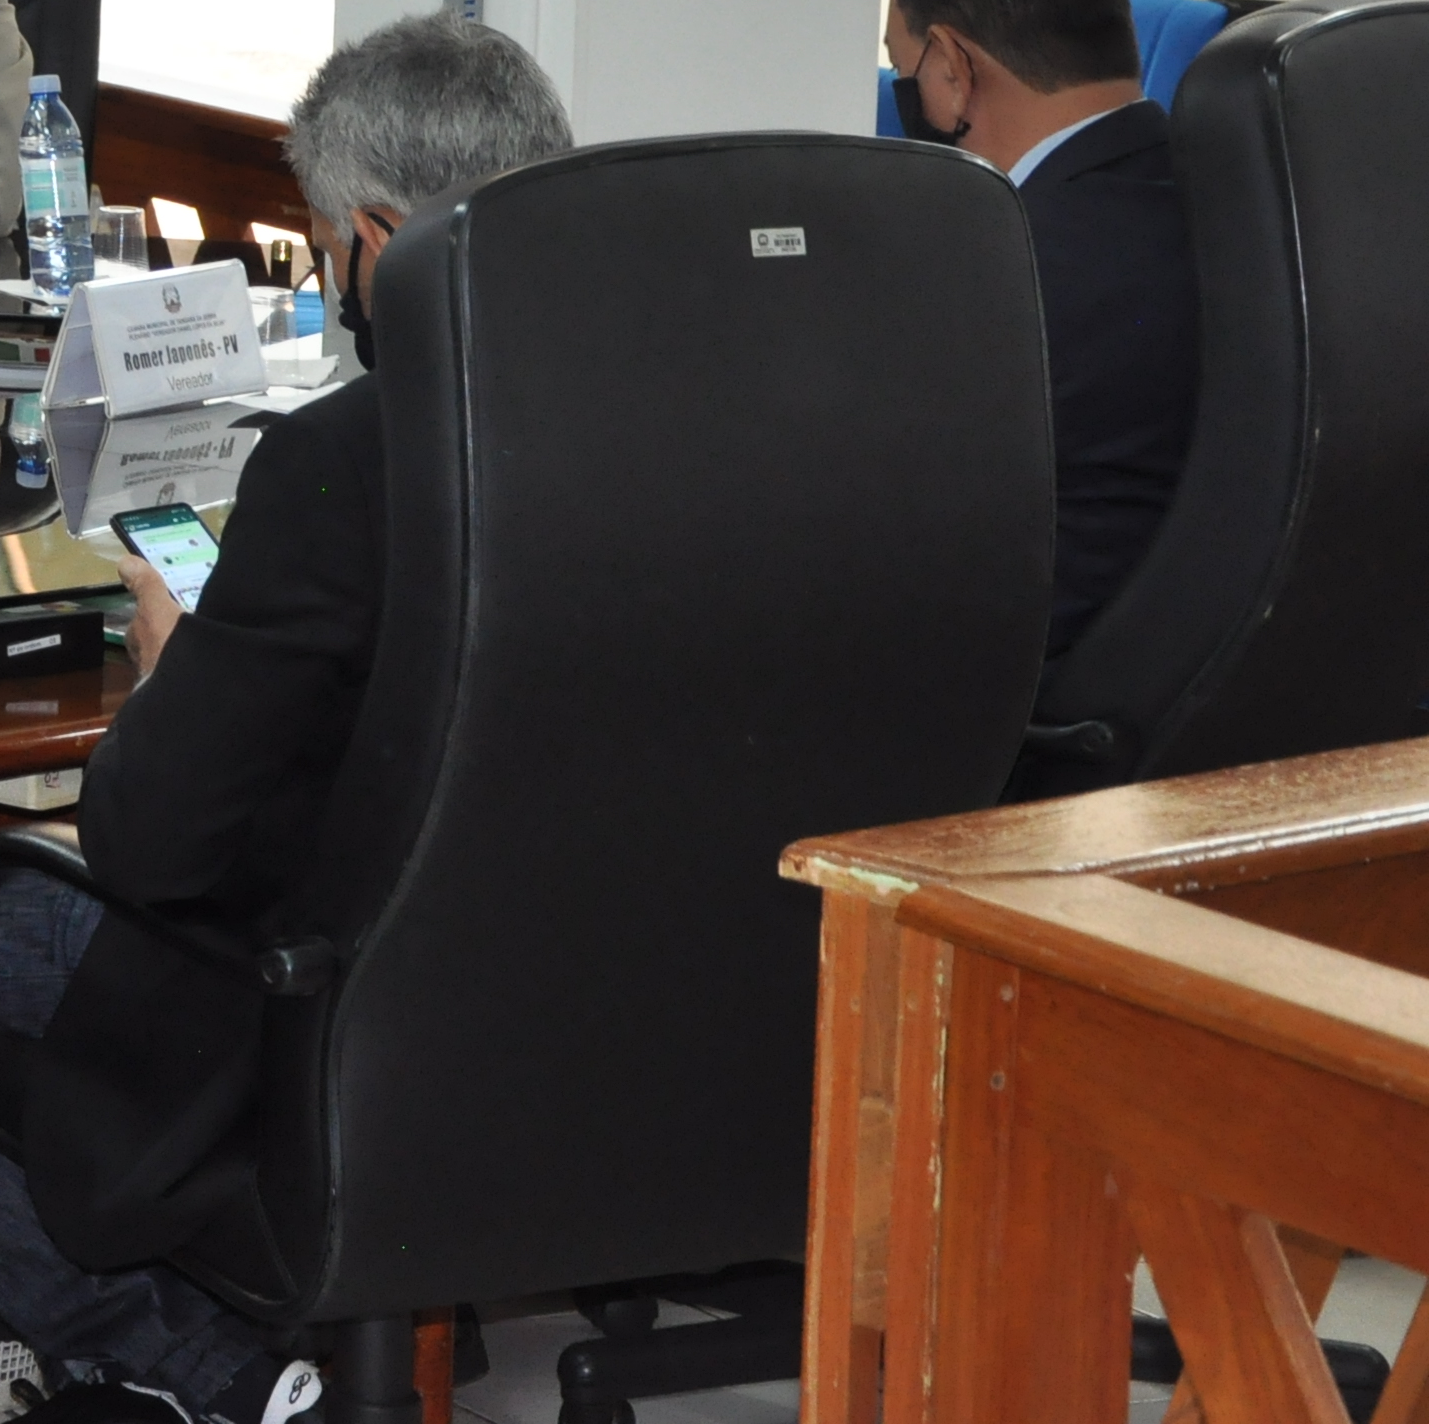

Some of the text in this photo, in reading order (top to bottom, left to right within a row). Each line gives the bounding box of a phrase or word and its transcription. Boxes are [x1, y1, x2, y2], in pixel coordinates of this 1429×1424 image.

[124, 350, 163, 372] Romer
[166, 339, 215, 364] Japonês
[223, 334, 239, 354] PV
[167, 372, 213, 391] Vereador
